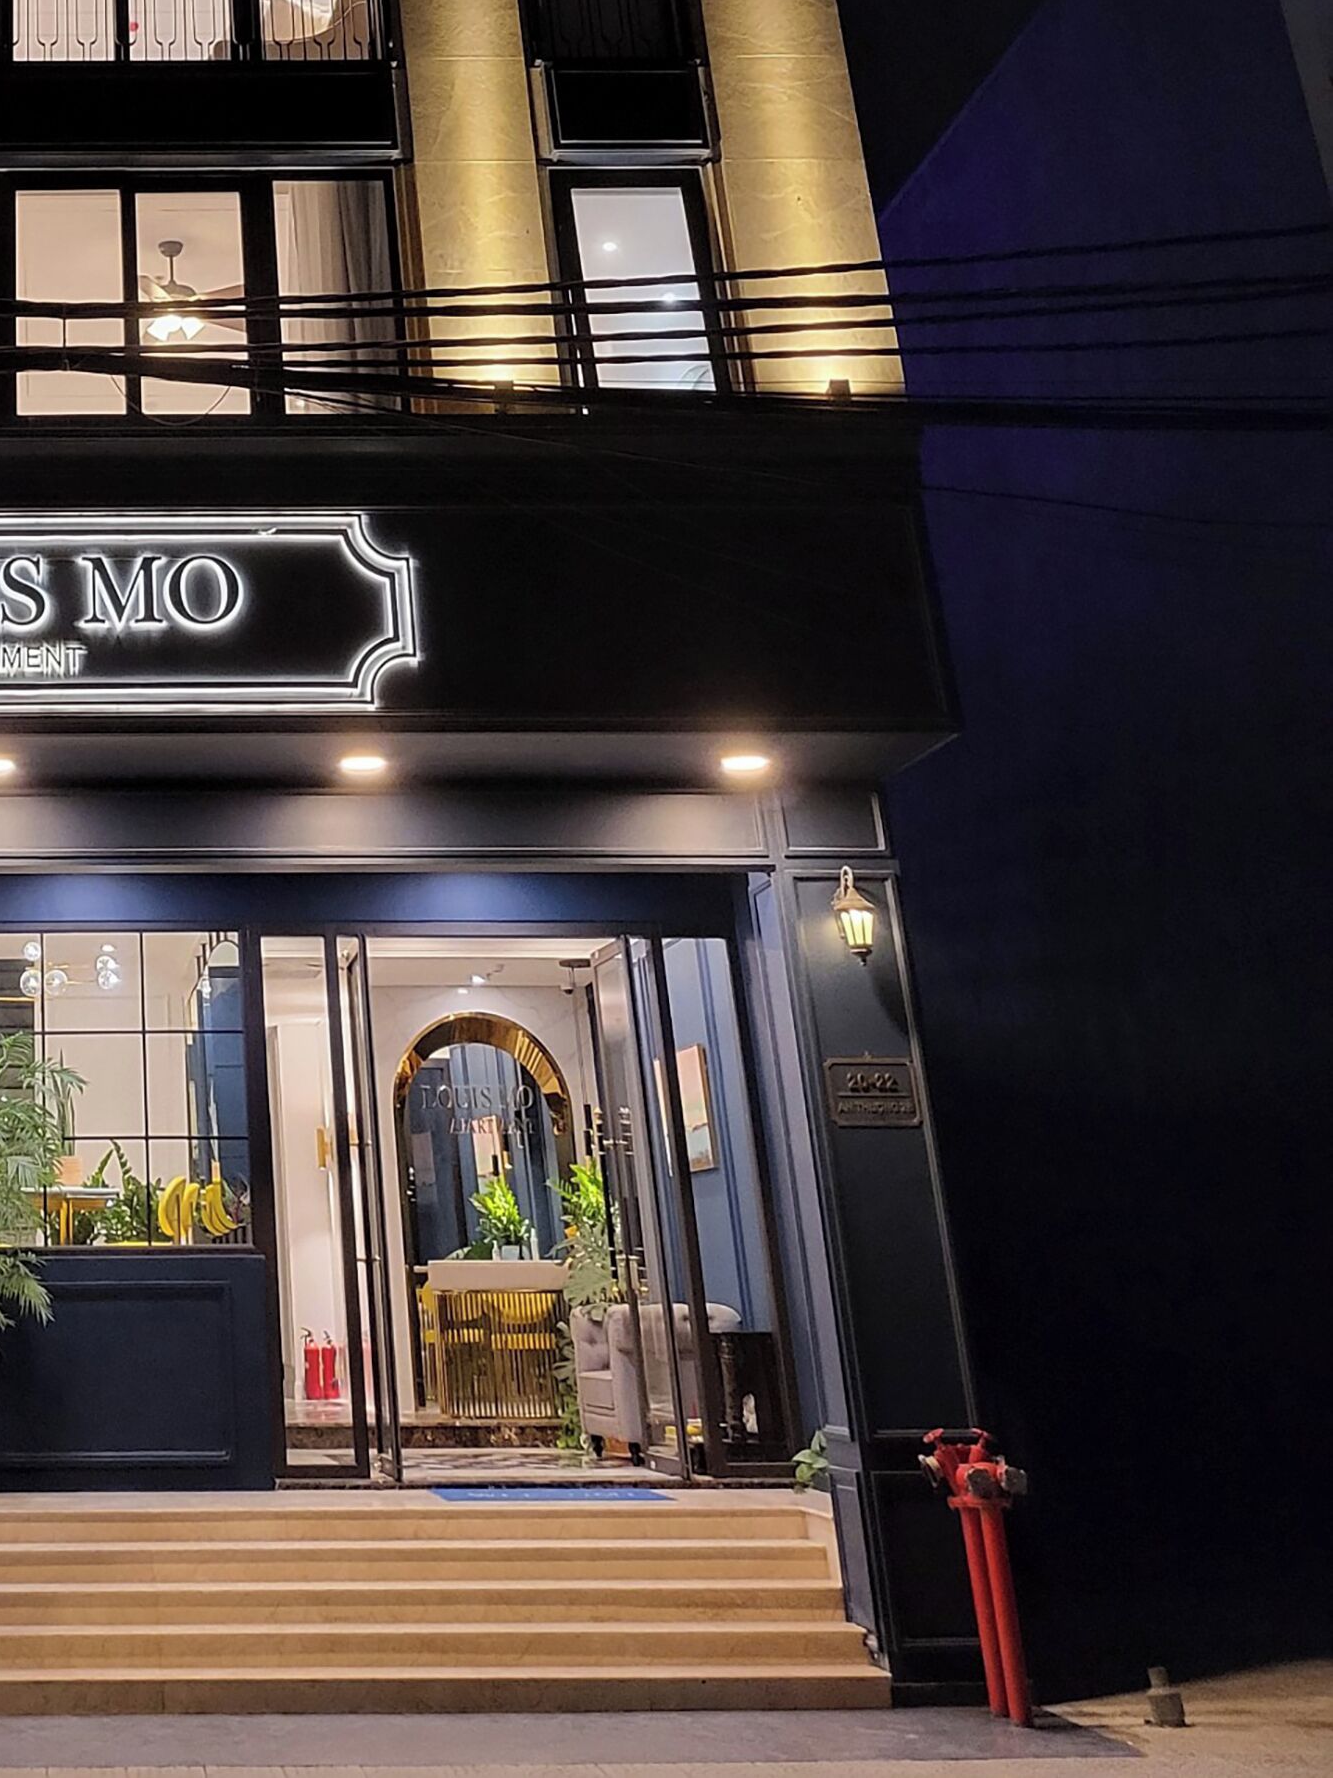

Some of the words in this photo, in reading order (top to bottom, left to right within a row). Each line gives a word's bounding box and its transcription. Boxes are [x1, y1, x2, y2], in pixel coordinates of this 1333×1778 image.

[78, 554, 243, 630] MO
[846, 1071, 899, 1093] 20-22
[419, 1084, 492, 1109] LOUIS
